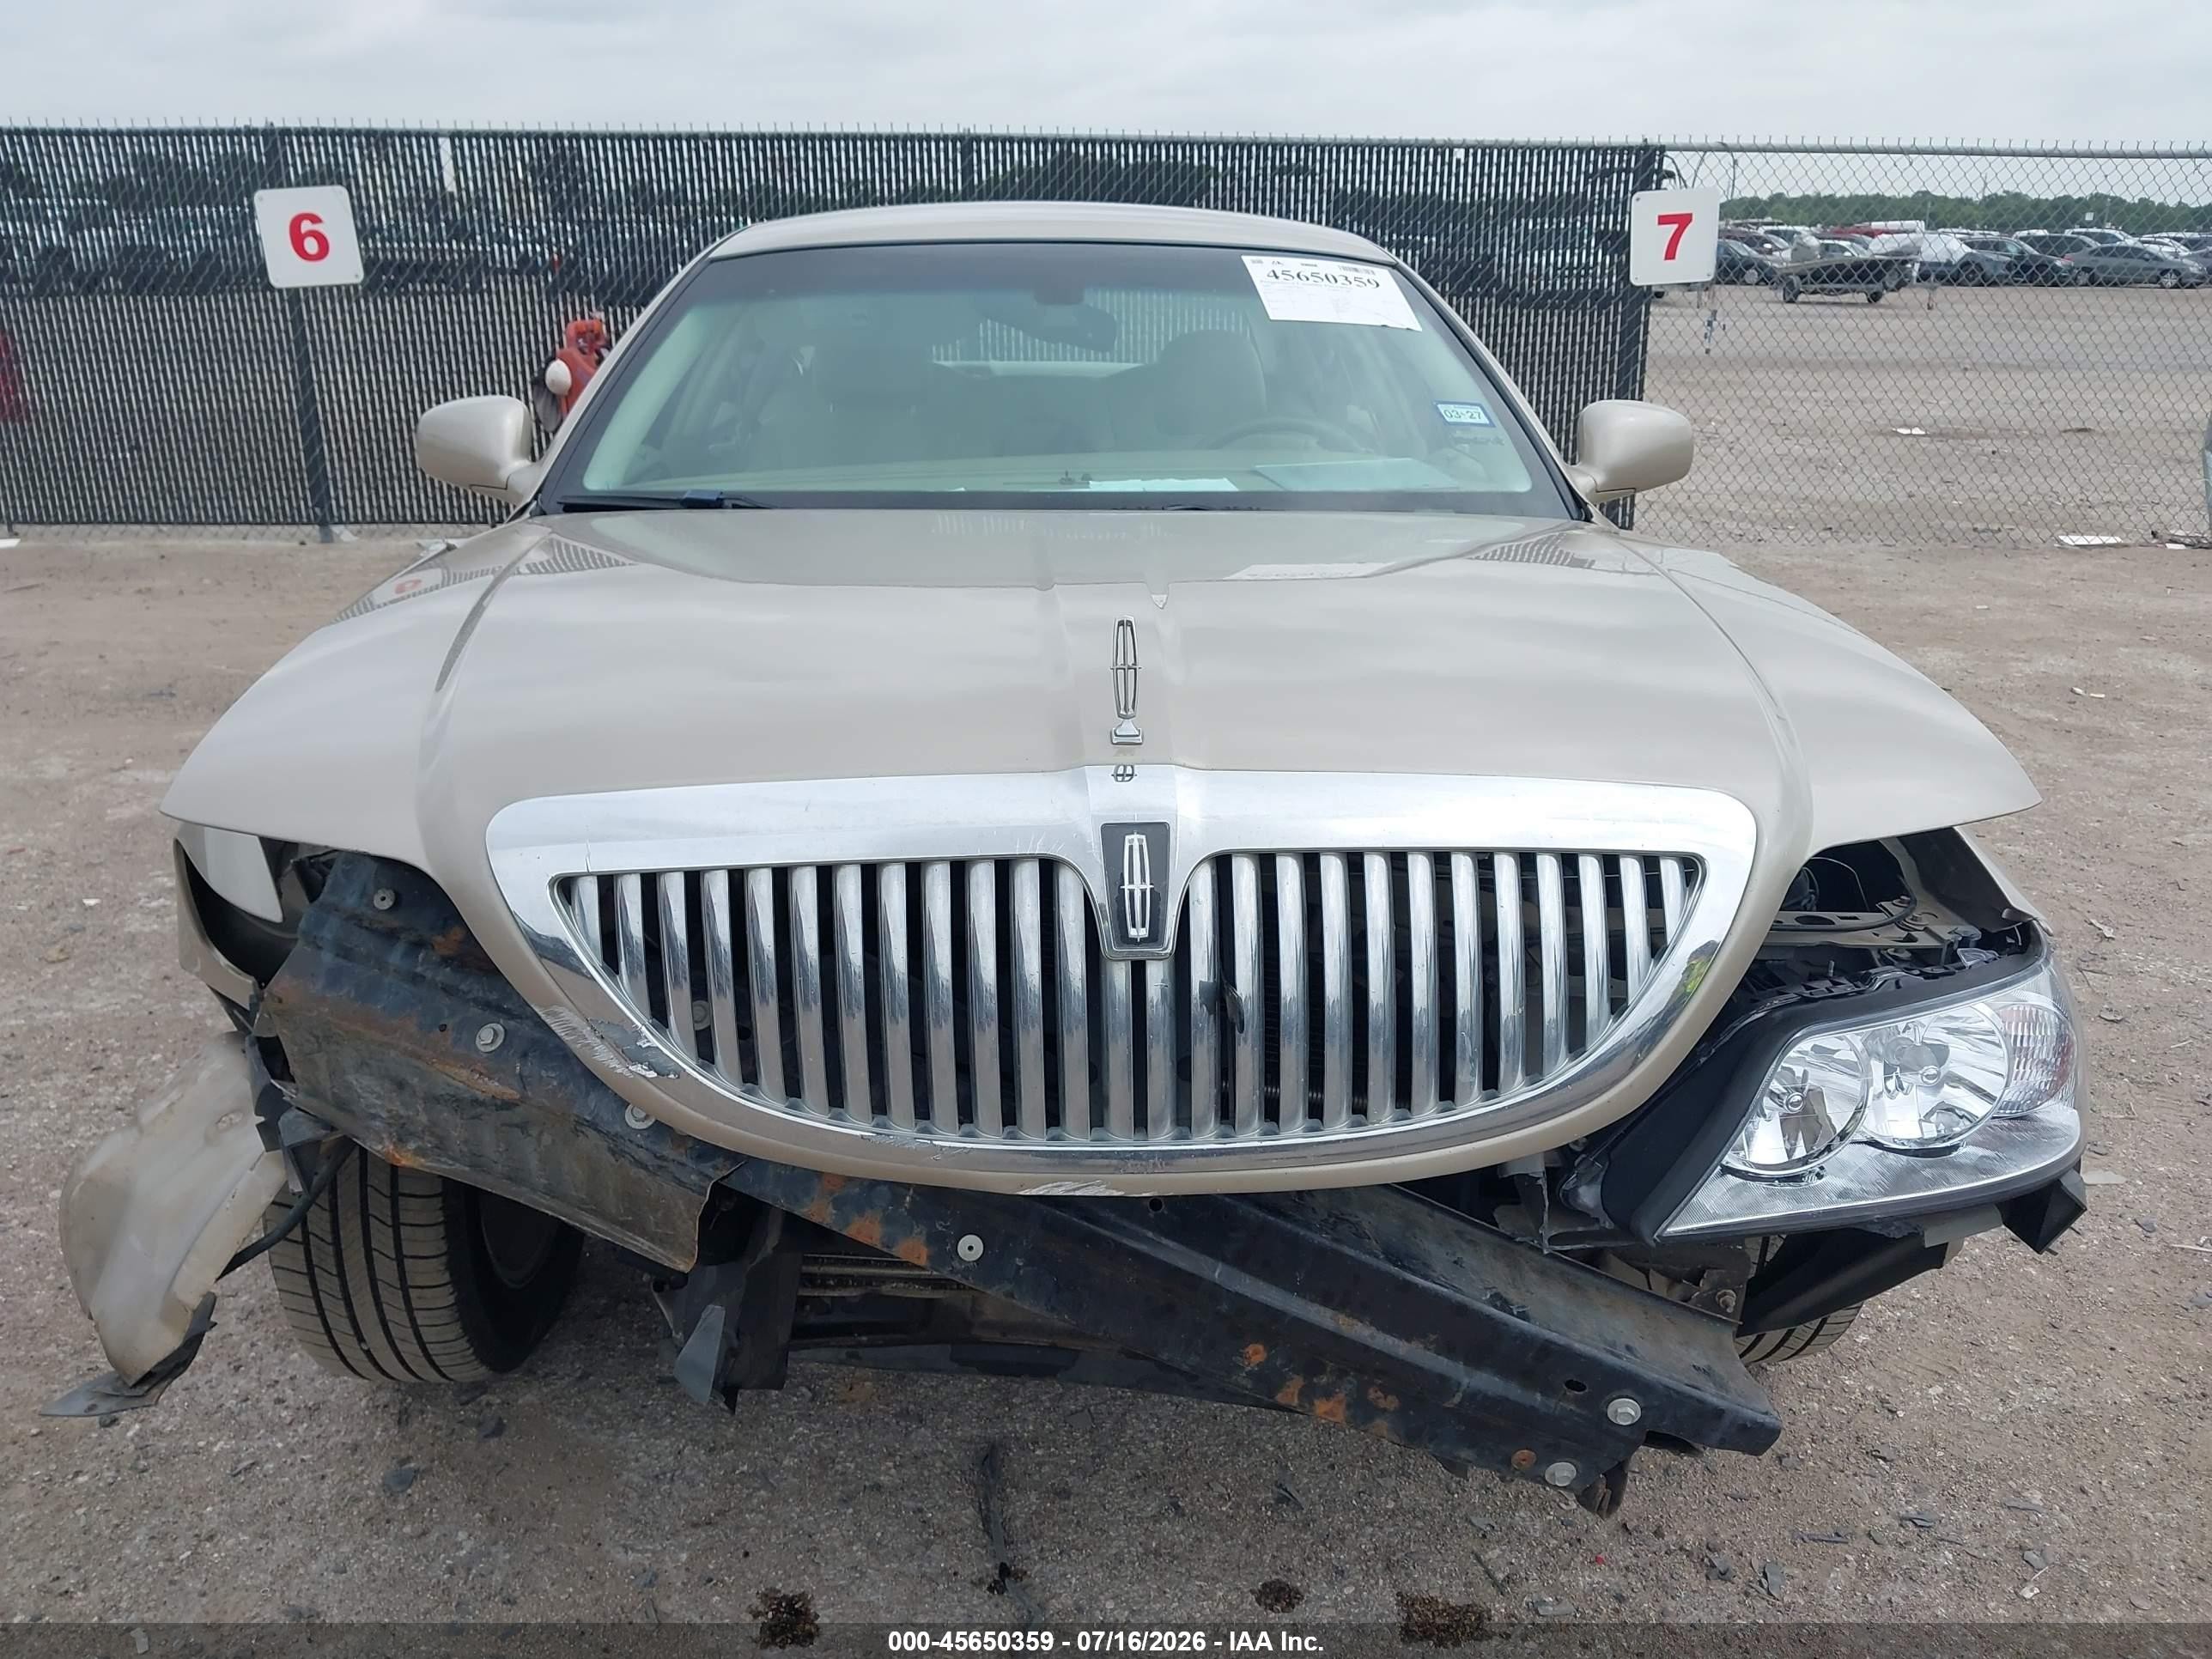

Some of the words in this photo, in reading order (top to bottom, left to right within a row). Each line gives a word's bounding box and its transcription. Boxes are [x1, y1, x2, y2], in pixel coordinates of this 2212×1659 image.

[289, 213, 330, 261] 6
[1658, 214, 1692, 260] 7
[1267, 269, 1380, 289] 45650359
